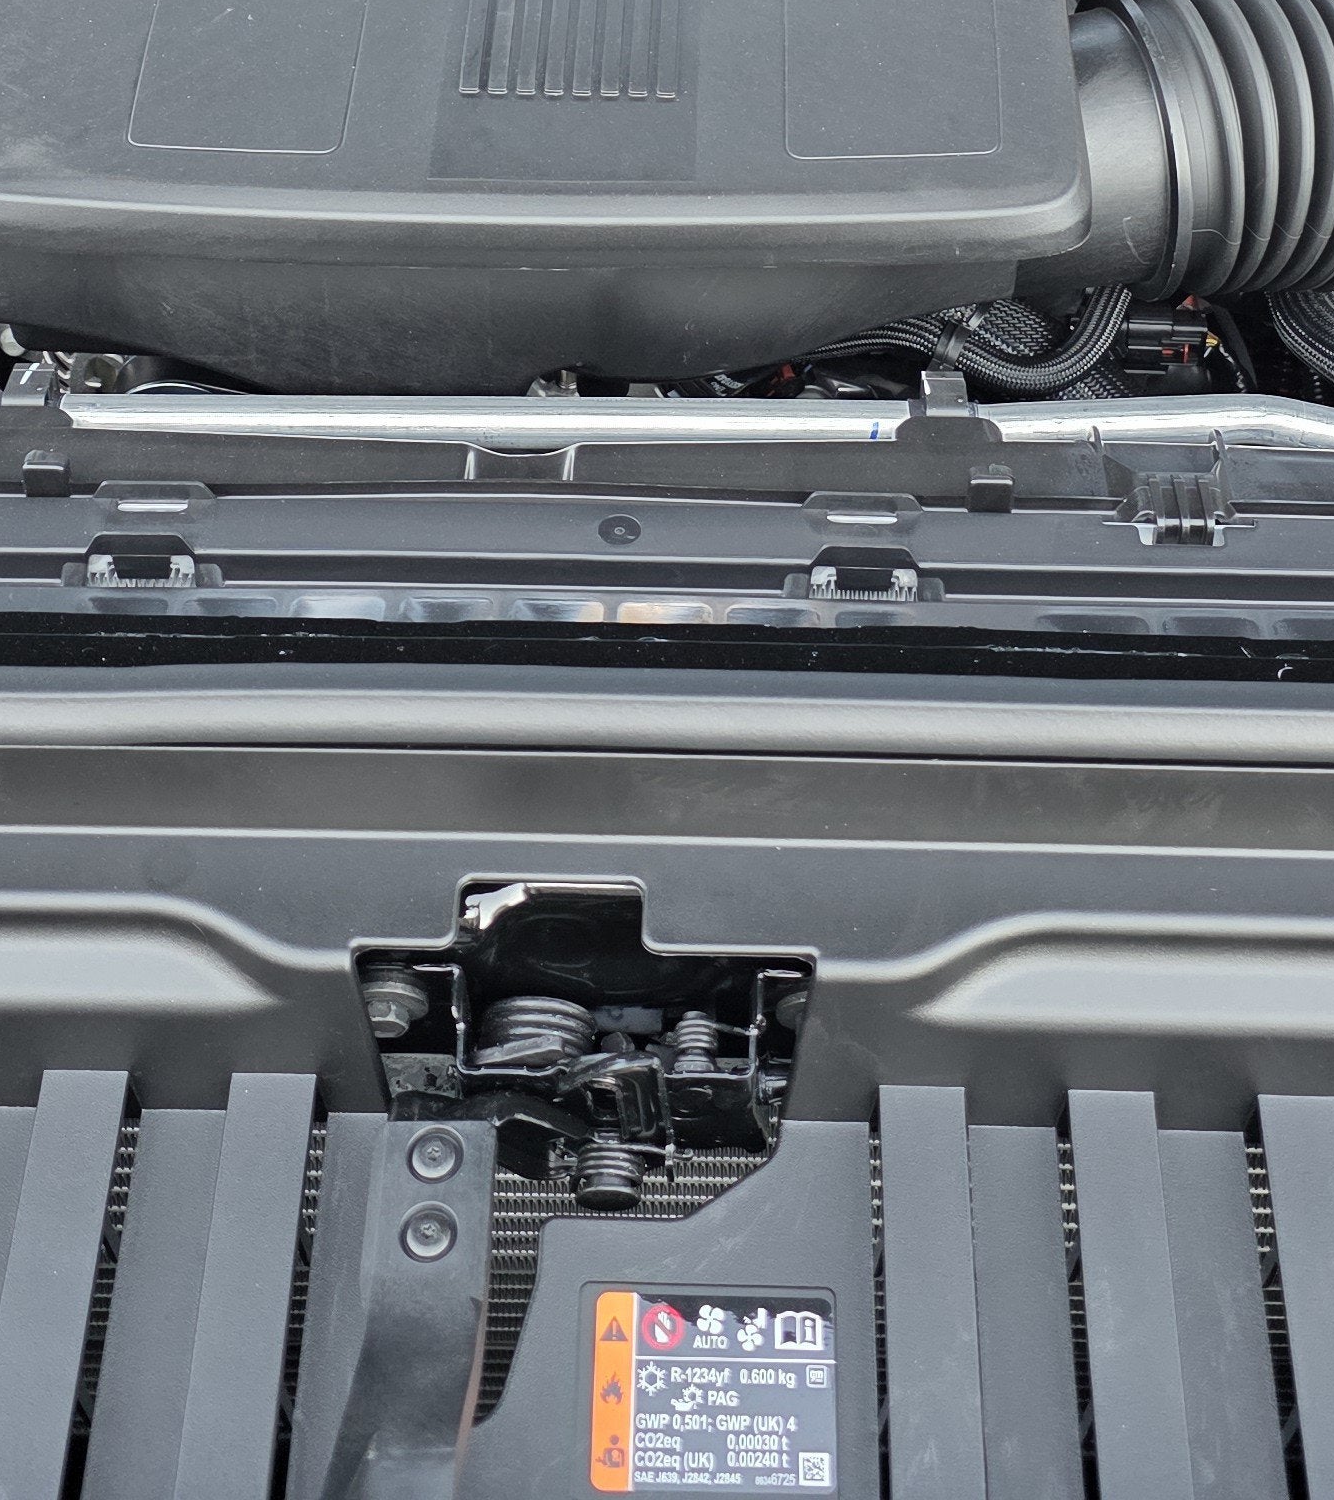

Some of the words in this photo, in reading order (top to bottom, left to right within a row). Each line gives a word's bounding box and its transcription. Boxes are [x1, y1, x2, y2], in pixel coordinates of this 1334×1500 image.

[693, 1335, 728, 1349] AUTO
[671, 1367, 731, 1386] R-1234yf
[739, 1368, 775, 1384] 0.600
[779, 1369, 796, 1388] kg
[707, 1390, 739, 1406] PAG
[635, 1414, 669, 1429] GWP
[672, 1414, 713, 1432] 0,501;
[716, 1414, 751, 1431] GWP
[754, 1416, 783, 1435] (UK)
[787, 1416, 797, 1432] 4
[635, 1432, 683, 1452] CO2eq
[782, 1436, 789, 1450] t
[635, 1451, 681, 1470] CO2eq
[683, 1452, 714, 1471] (UK)
[727, 1451, 779, 1468] 0.00240
[782, 1452, 789, 1468] t
[634, 1471, 655, 1483] SAE
